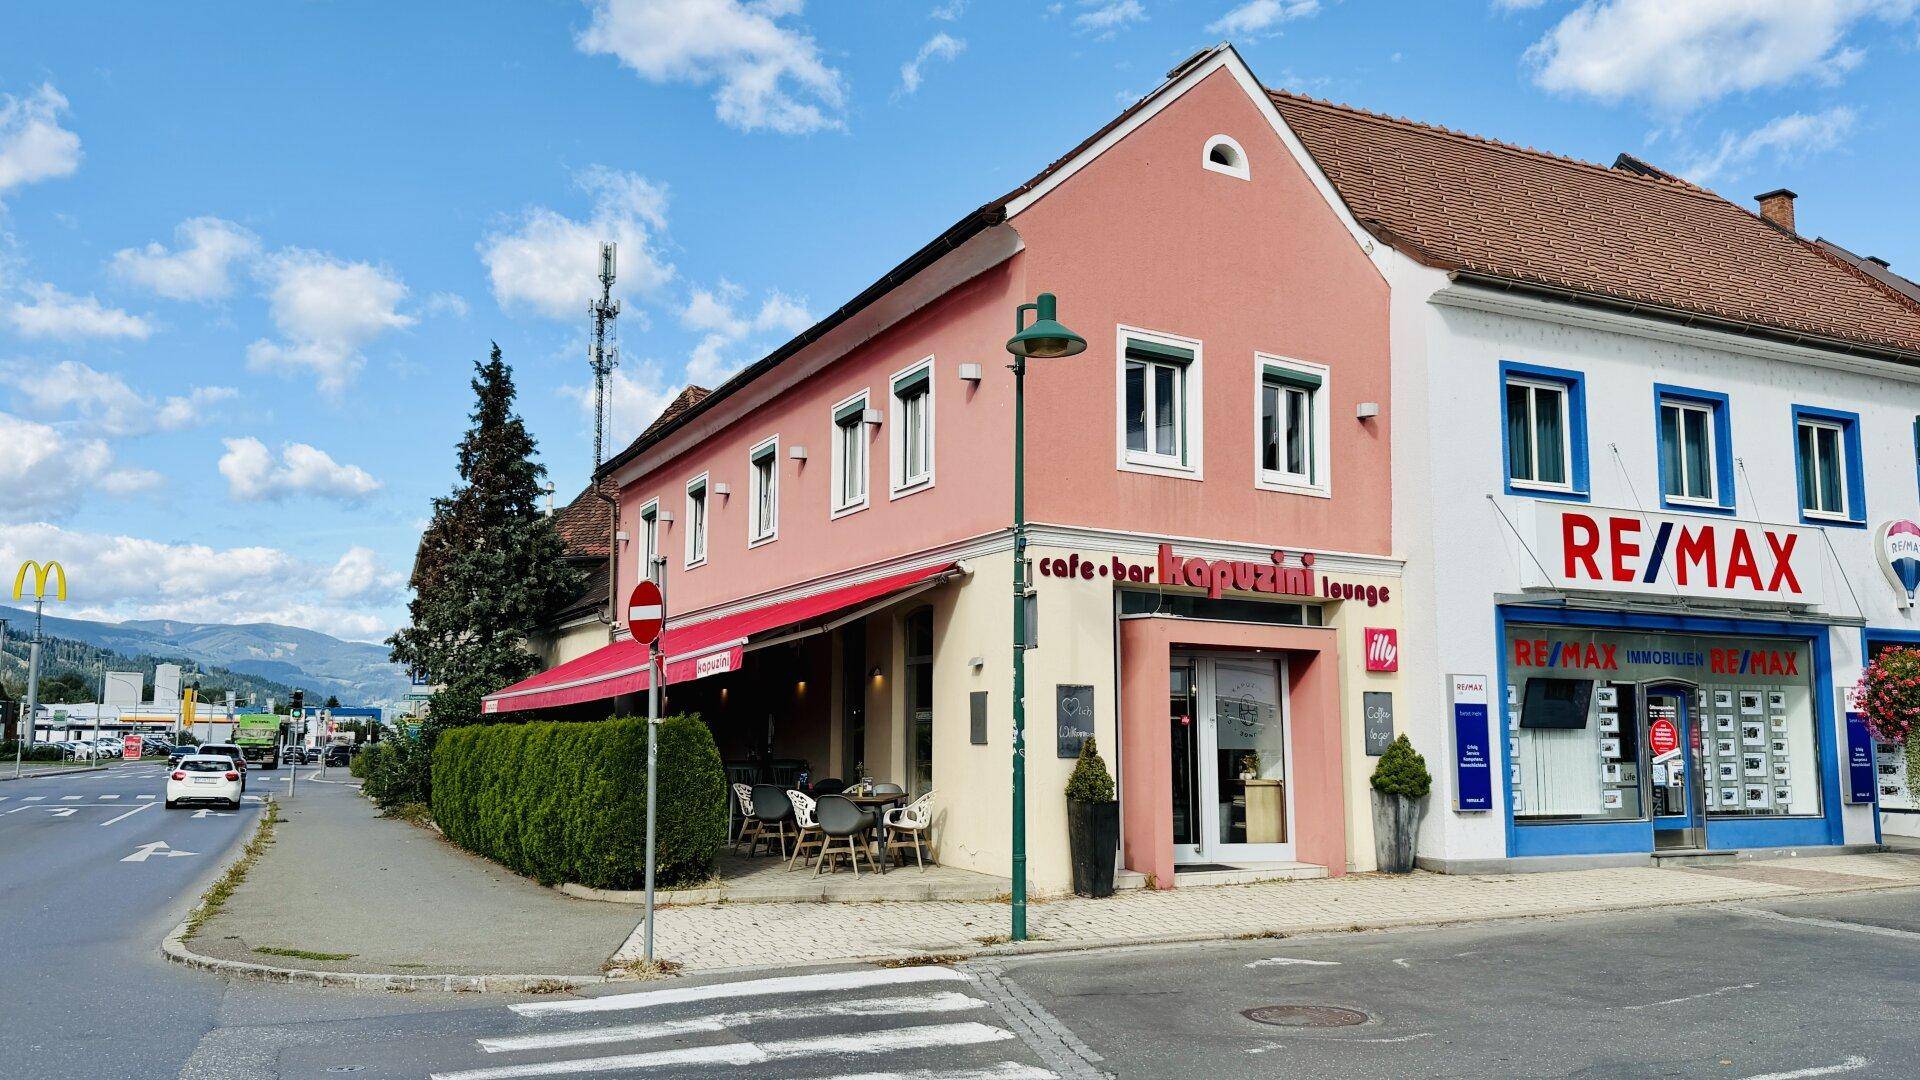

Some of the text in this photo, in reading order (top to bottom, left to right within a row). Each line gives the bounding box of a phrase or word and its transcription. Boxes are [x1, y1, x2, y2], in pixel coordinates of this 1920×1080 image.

[1562, 512, 1802, 594] RE/MAX
[1891, 540, 1920, 554] RE/MA
[1039, 543, 1391, 608] cafe bar kapuzini lounge
[697, 652, 730, 675] kapuzini
[1370, 633, 1397, 668] illy
[1514, 639, 1799, 676] RE/MAX IMMOBILIEN RE/MAX
